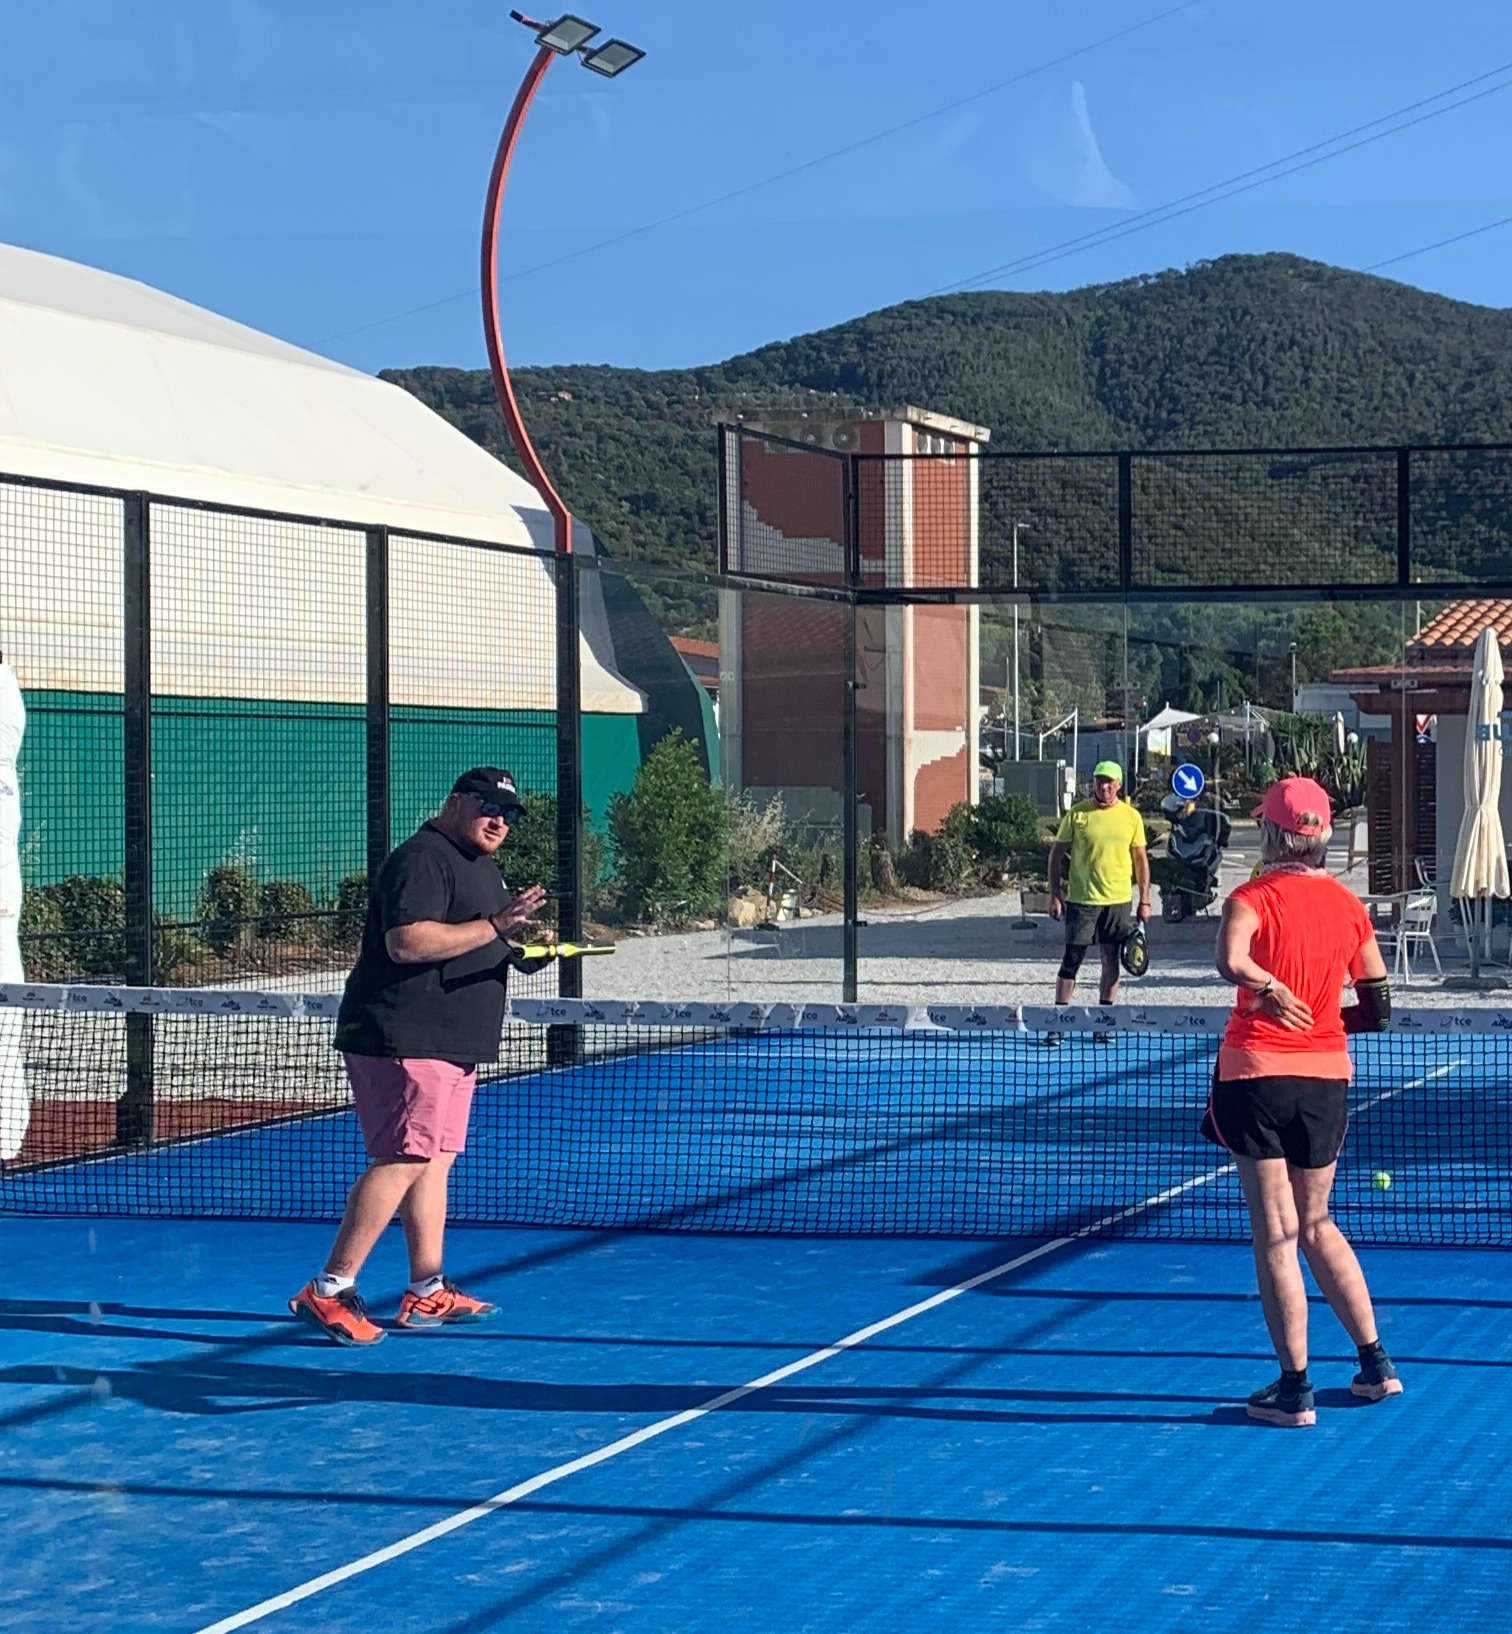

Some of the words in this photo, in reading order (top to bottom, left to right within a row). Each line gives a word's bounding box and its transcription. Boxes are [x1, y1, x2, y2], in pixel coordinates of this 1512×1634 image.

[550, 1006, 567, 1016] tce
[675, 1008, 692, 1019] tce
[802, 1010, 818, 1020] tce
[930, 1012, 947, 1022] tce
[1059, 1013, 1076, 1023] tce
[1189, 1016, 1205, 1025] tce
[1454, 1016, 1472, 1026] tce
